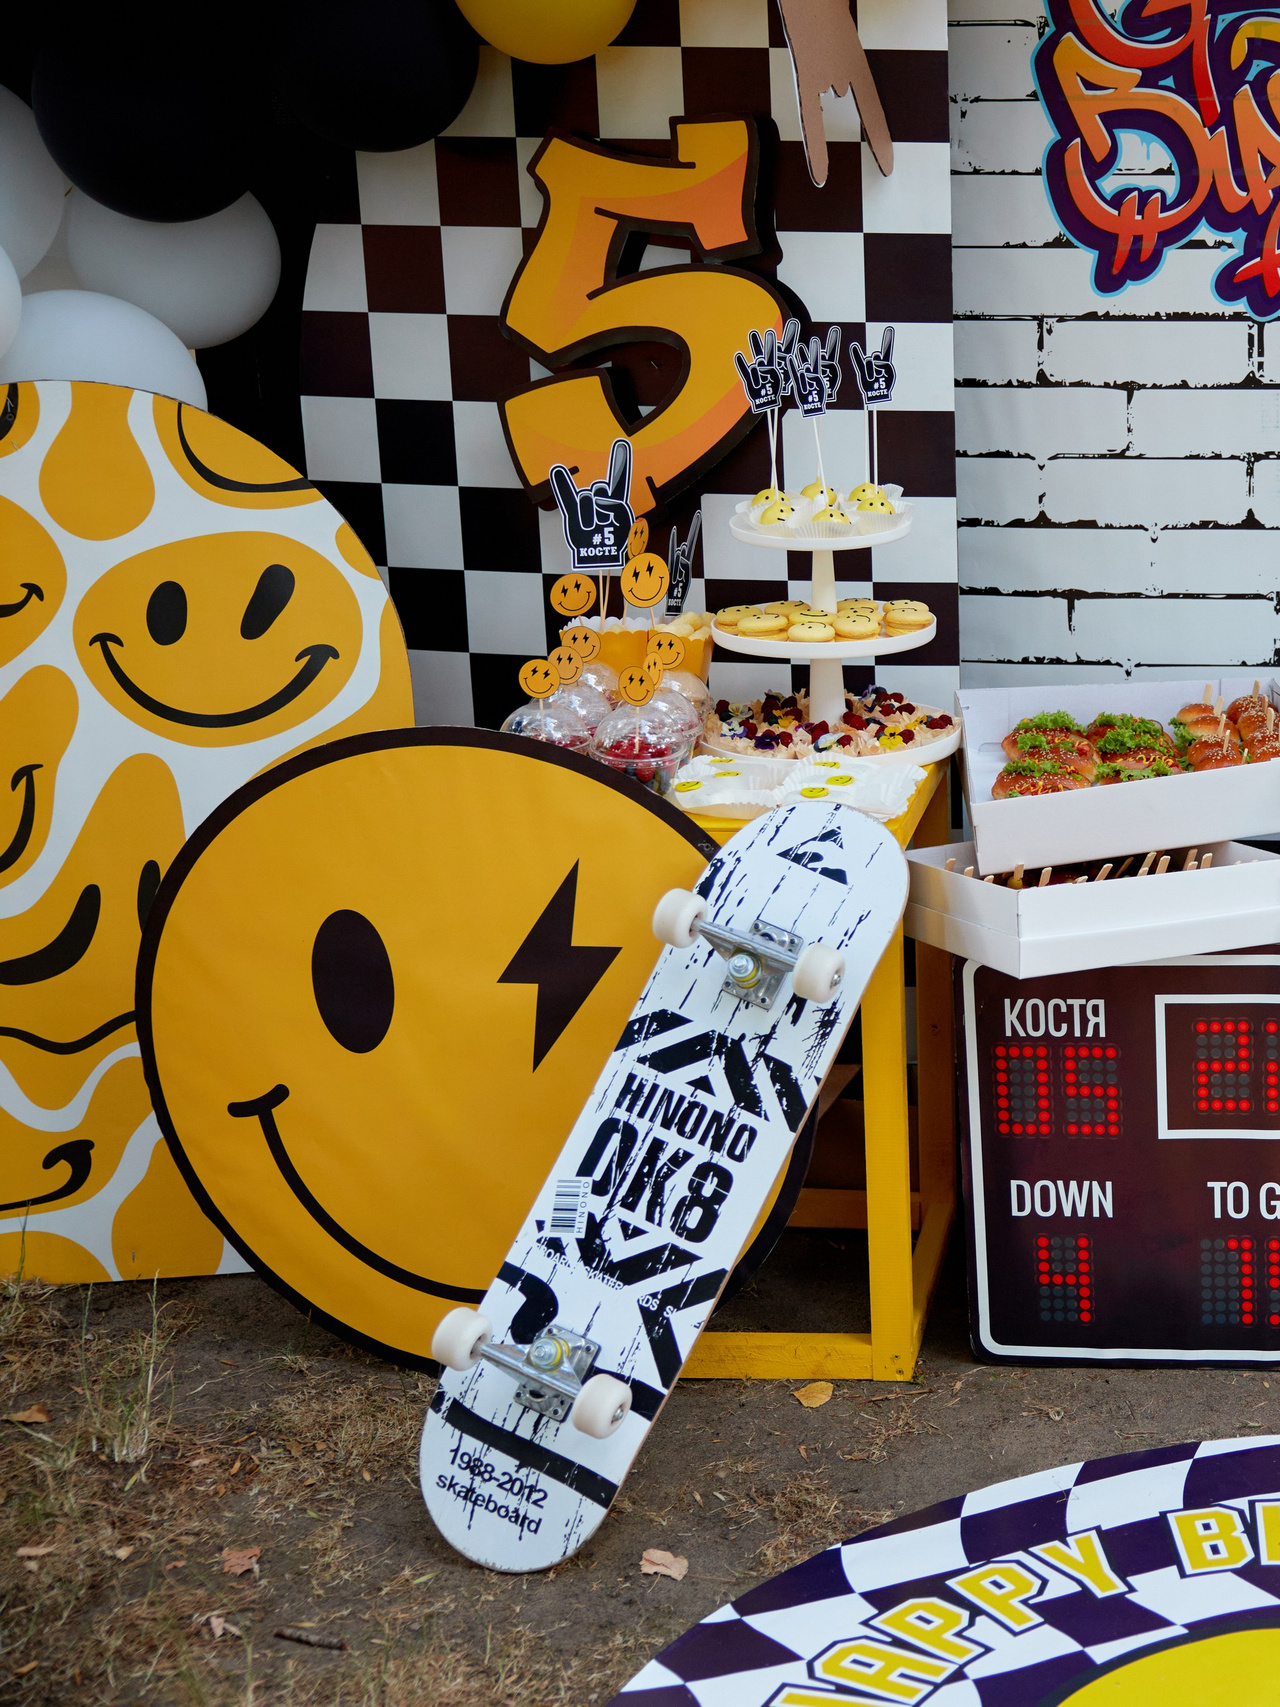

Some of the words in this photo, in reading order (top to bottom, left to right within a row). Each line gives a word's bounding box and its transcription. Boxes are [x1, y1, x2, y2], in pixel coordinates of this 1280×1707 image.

[500, 112, 792, 518] 5
[760, 383, 774, 396] #5
[807, 390, 819, 403] #5
[872, 377, 887, 390] #5
[579, 546, 618, 558] КОСТЕ
[592, 526, 615, 546] #5
[1003, 998, 1106, 1038] КОСТЯ
[994, 1045, 1120, 1136] 05
[614, 1072, 758, 1163] HINONO
[575, 1180, 591, 1234] HINONO
[1009, 1179, 1114, 1219] DOWN
[1206, 1181, 1250, 1220] TO
[1036, 1235, 1092, 1323] 4
[448, 1444, 549, 1509] 1988-2012
[435, 1472, 543, 1535] skateboard
